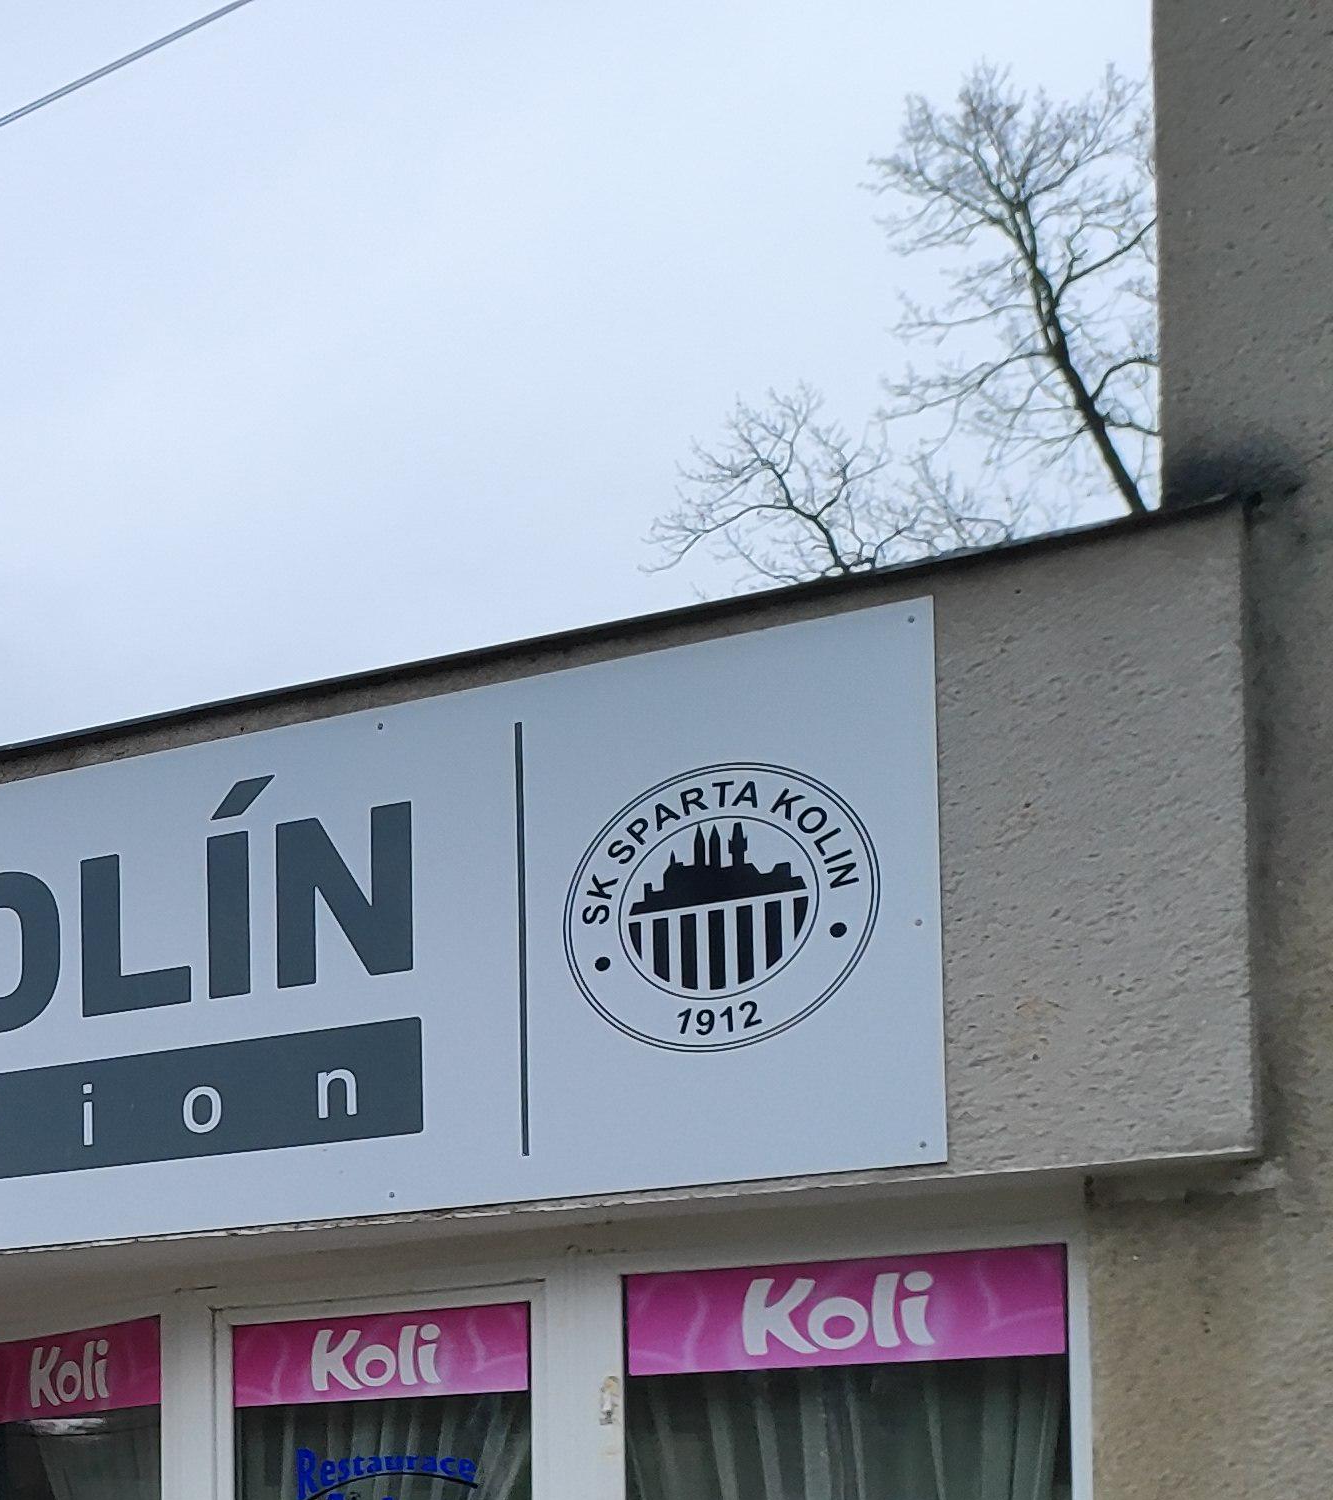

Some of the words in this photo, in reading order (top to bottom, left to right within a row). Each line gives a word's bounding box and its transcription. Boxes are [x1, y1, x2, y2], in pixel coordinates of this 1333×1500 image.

[582, 874, 619, 925] SK
[608, 781, 758, 864] SPARTA
[677, 1000, 762, 1036] 1912
[741, 1270, 935, 1355] Koli
[30, 1339, 109, 1408] Koli
[311, 1323, 441, 1391] Koli
[296, 1447, 478, 1500] Restaurace
